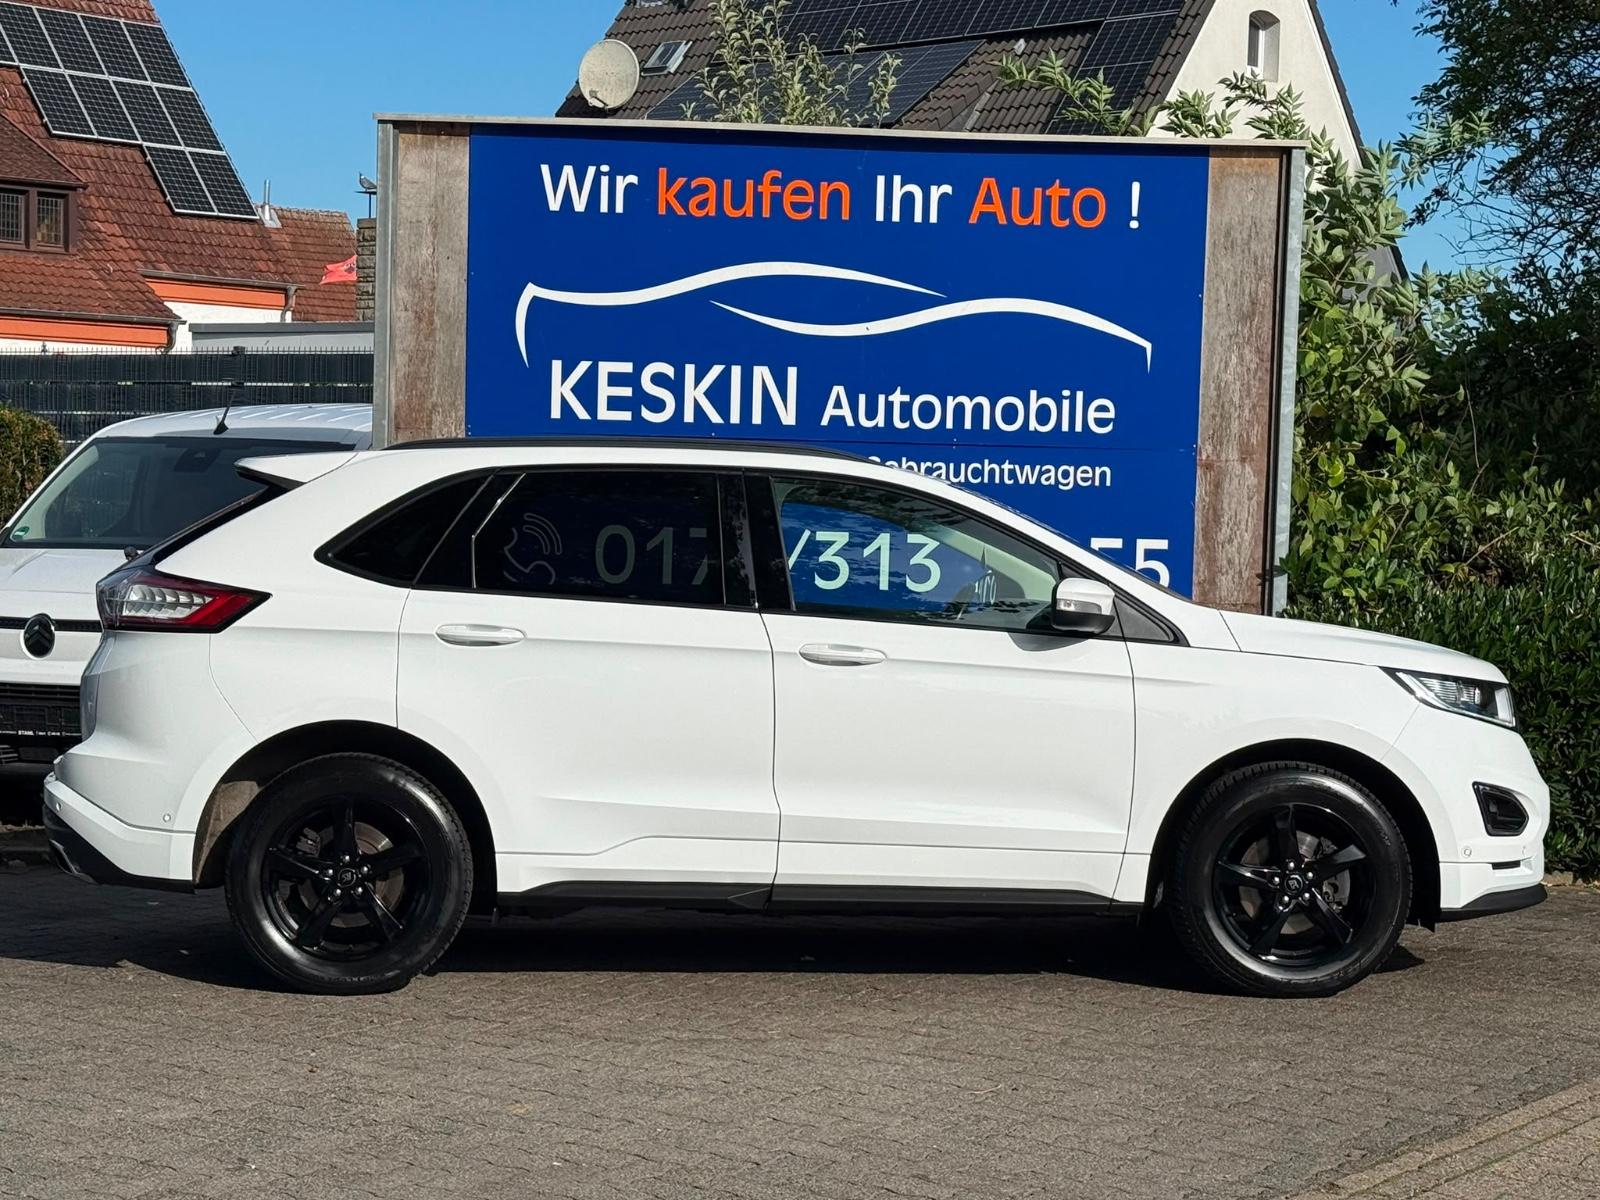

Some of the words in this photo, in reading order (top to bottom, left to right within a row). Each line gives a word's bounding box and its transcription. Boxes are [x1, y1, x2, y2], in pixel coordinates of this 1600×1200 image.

[540, 164, 639, 213] Wir
[657, 167, 851, 220] kaufen
[875, 174, 953, 223] Ihr
[968, 177, 1107, 229] Auto
[1129, 181, 1141, 229] !
[549, 359, 798, 426] KESKIN
[820, 384, 1116, 434] Automobile
[867, 455, 1112, 490] brauchtwagen
[1090, 537, 1171, 589] 5
